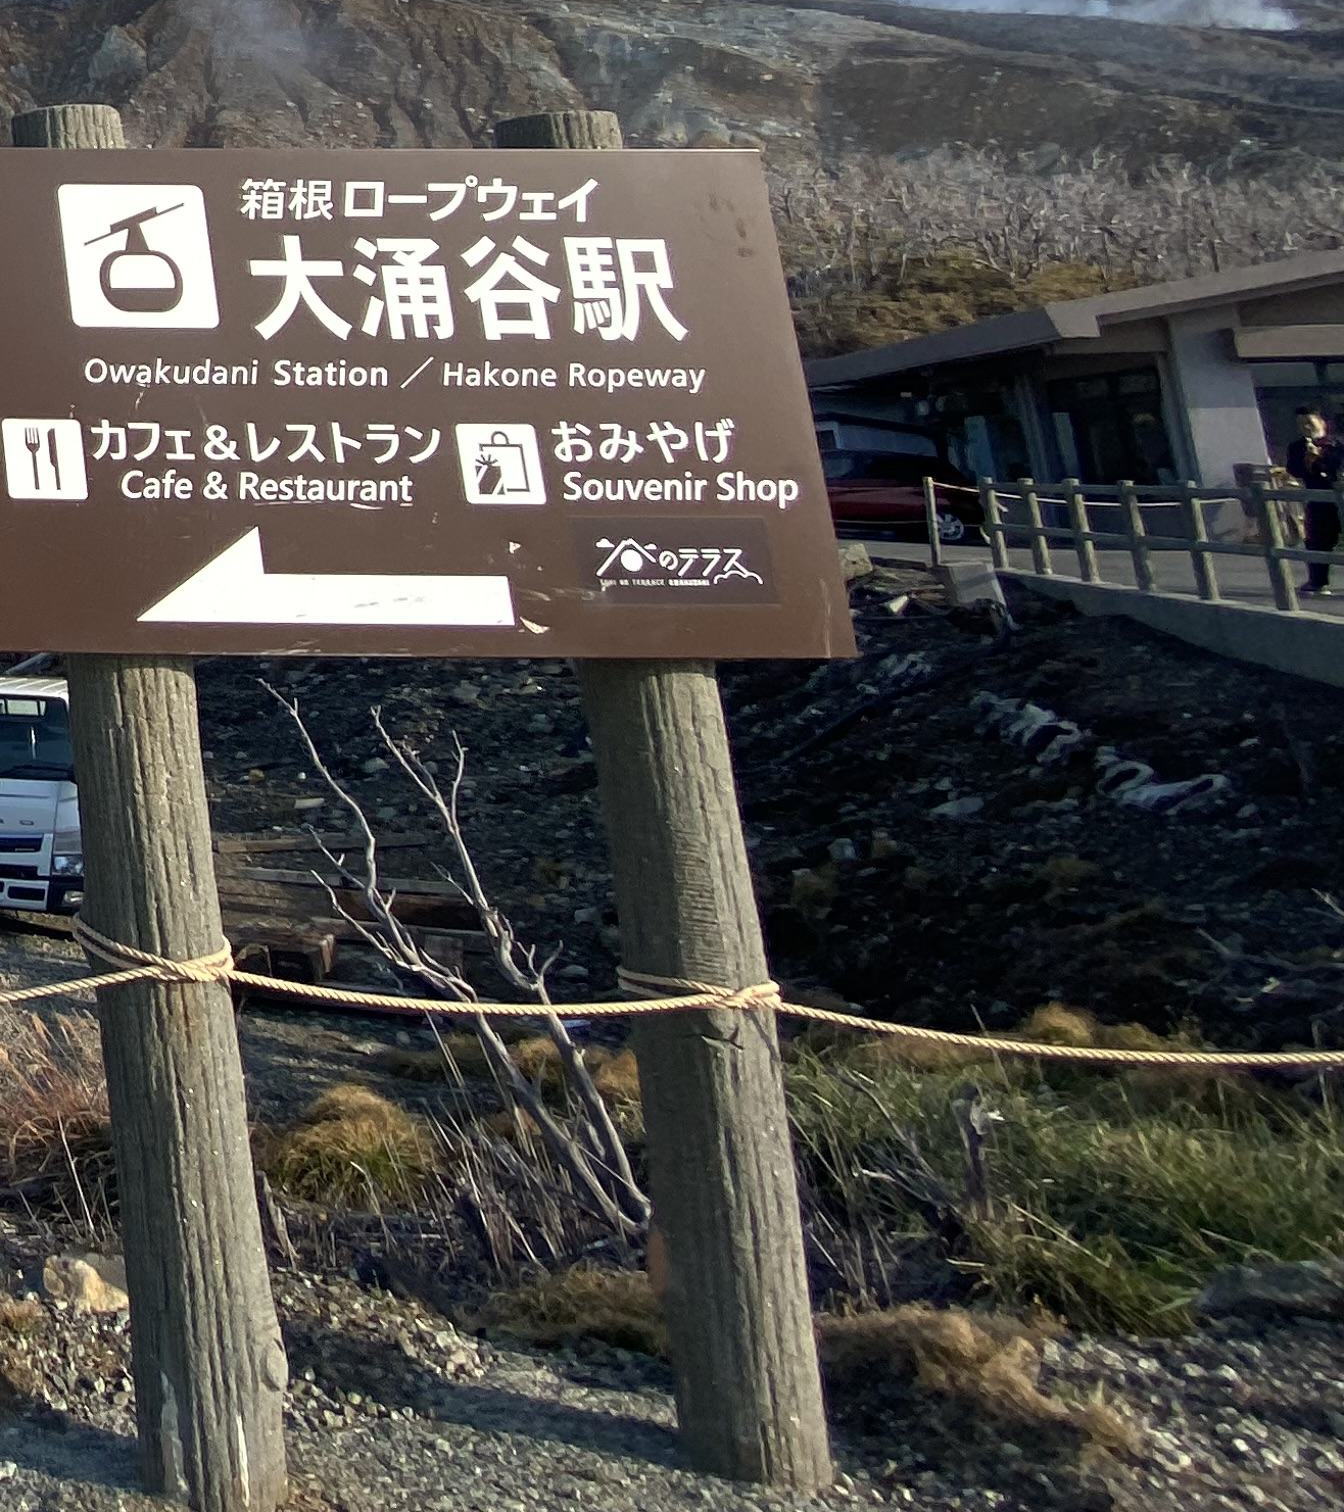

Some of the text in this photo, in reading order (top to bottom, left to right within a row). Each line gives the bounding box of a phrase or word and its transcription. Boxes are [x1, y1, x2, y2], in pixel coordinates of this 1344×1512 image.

[250, 234, 690, 342] 大涌谷駅
[84, 357, 259, 388] Owakudani
[273, 359, 388, 388] Station
[442, 360, 558, 389] Hakone
[568, 362, 706, 394] Ropeway
[551, 417, 736, 464] おみやげ
[121, 469, 414, 502] Cafe & Restaurant
[563, 470, 800, 509] Souvenir Shop
